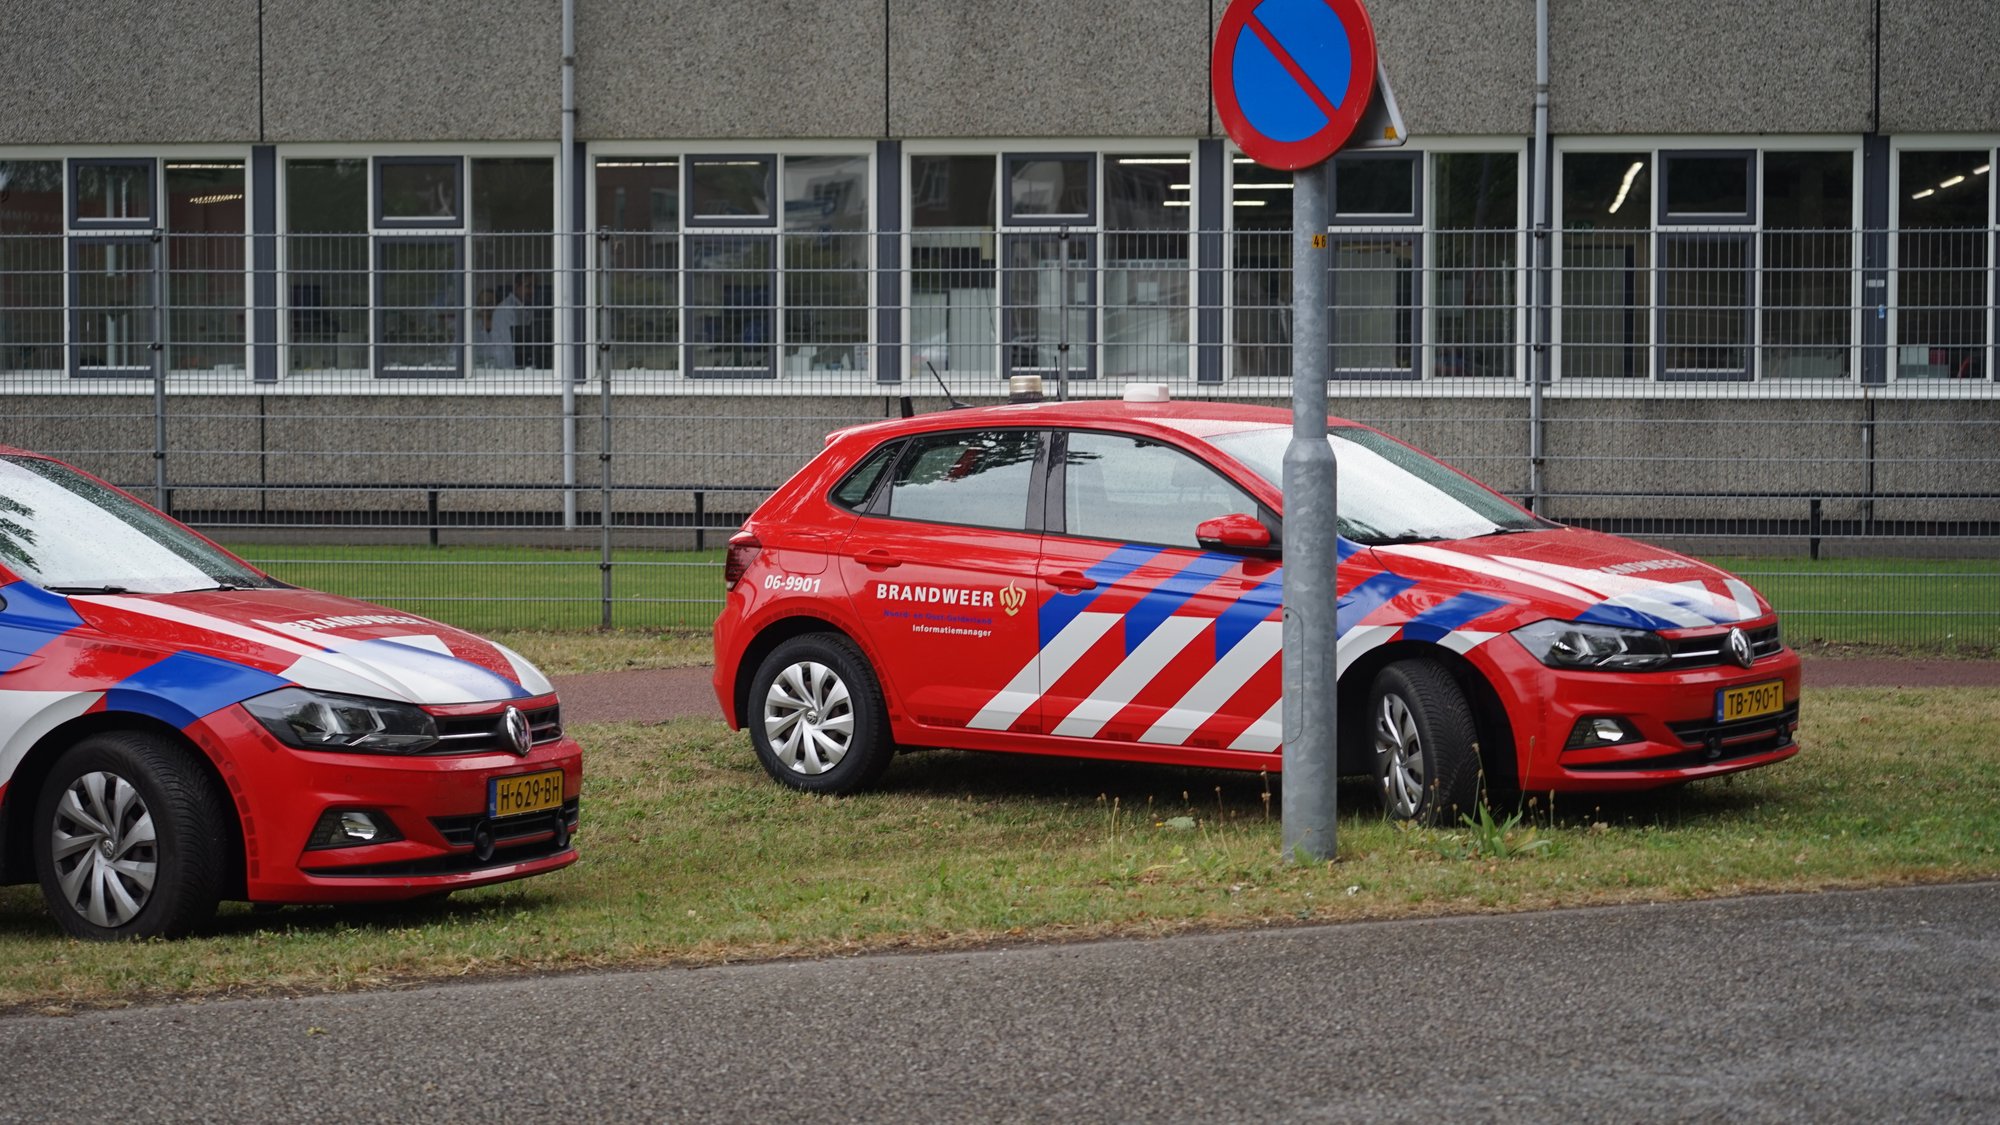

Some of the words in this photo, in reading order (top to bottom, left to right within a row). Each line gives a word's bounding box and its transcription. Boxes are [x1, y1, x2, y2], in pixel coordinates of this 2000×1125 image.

[1313, 235, 1327, 248] 46
[764, 574, 821, 593] 06-9901
[876, 583, 994, 607] BRANDWEER
[912, 624, 992, 638] Informatiemanager
[1728, 685, 1780, 715] TB-790-T
[500, 775, 560, 811] H-629-BH
